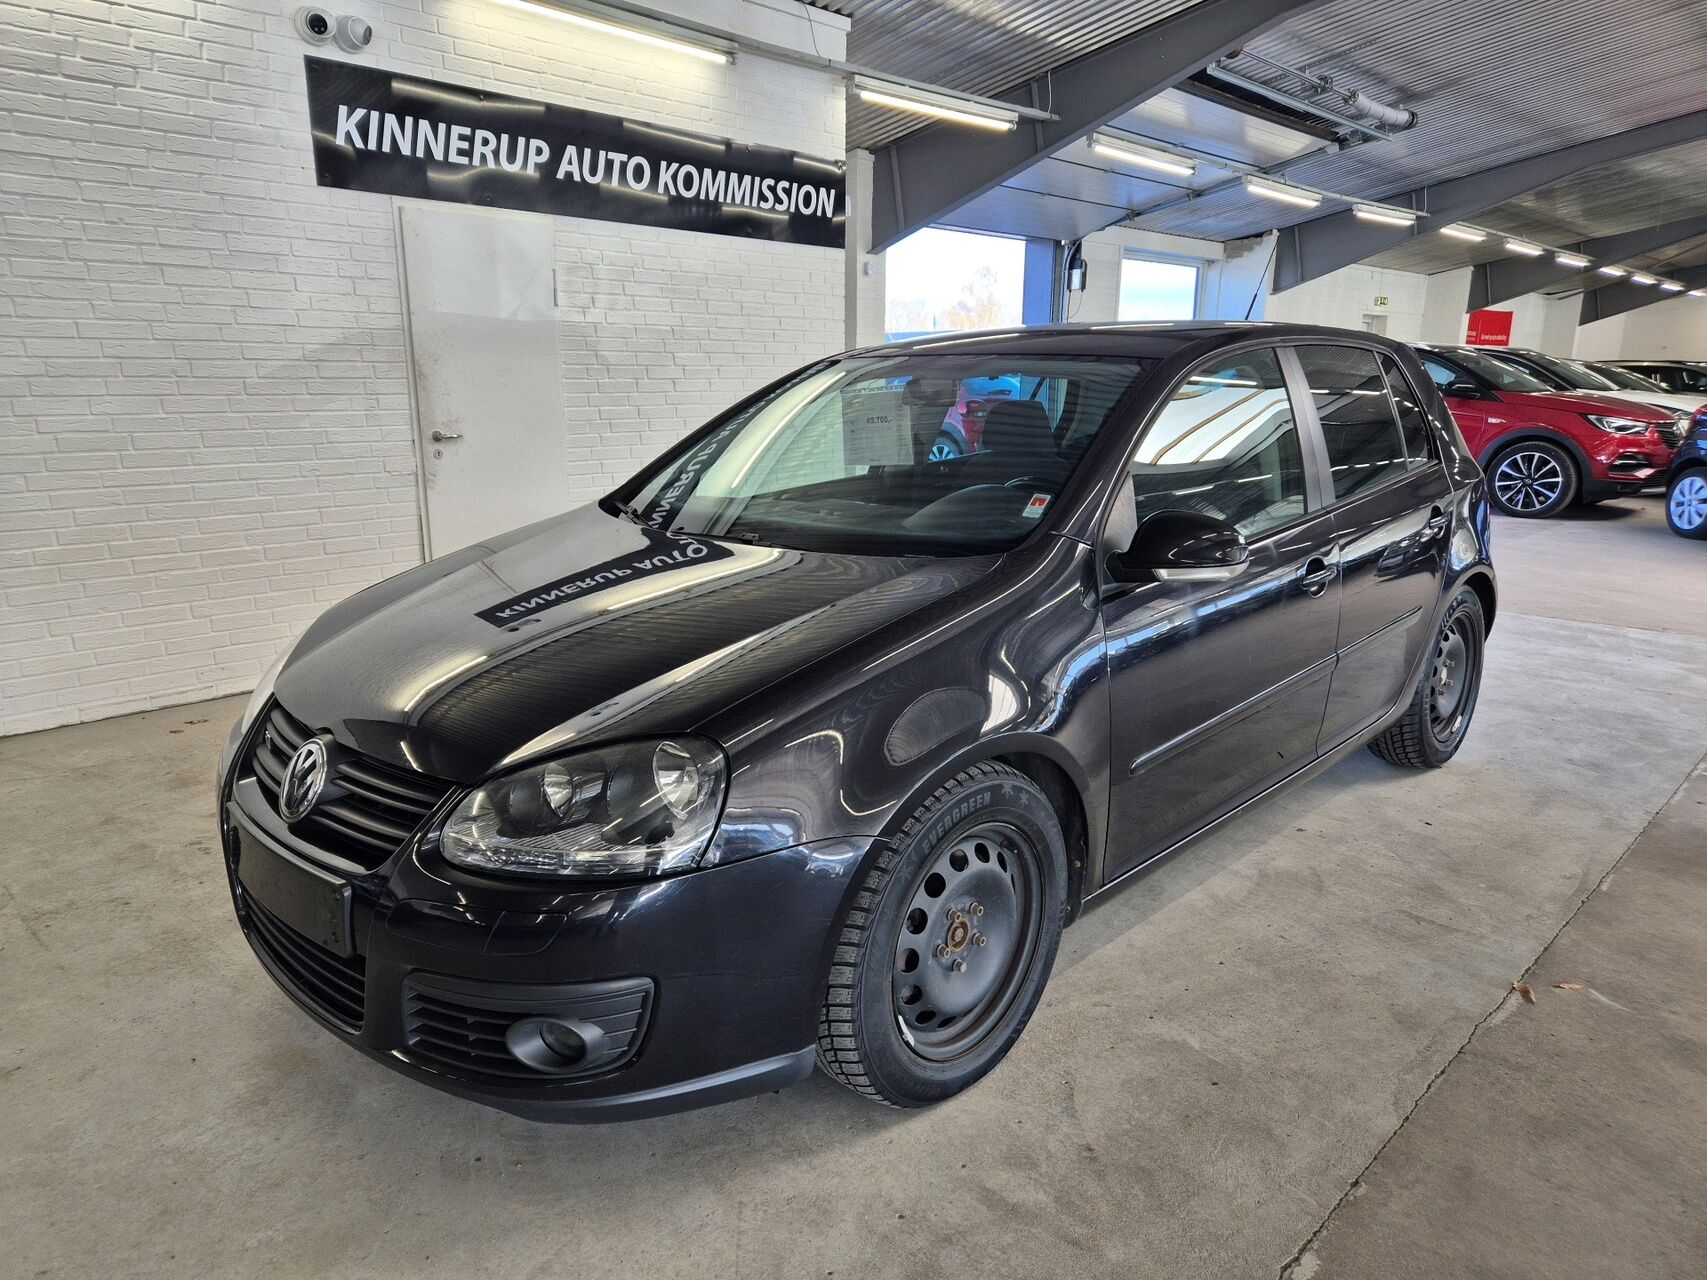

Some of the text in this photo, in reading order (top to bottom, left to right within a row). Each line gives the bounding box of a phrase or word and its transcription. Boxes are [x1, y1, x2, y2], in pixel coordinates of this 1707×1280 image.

[335, 104, 836, 218] KINNERUP AUTO KOMMISSION
[922, 791, 991, 854] EVERGREEN
